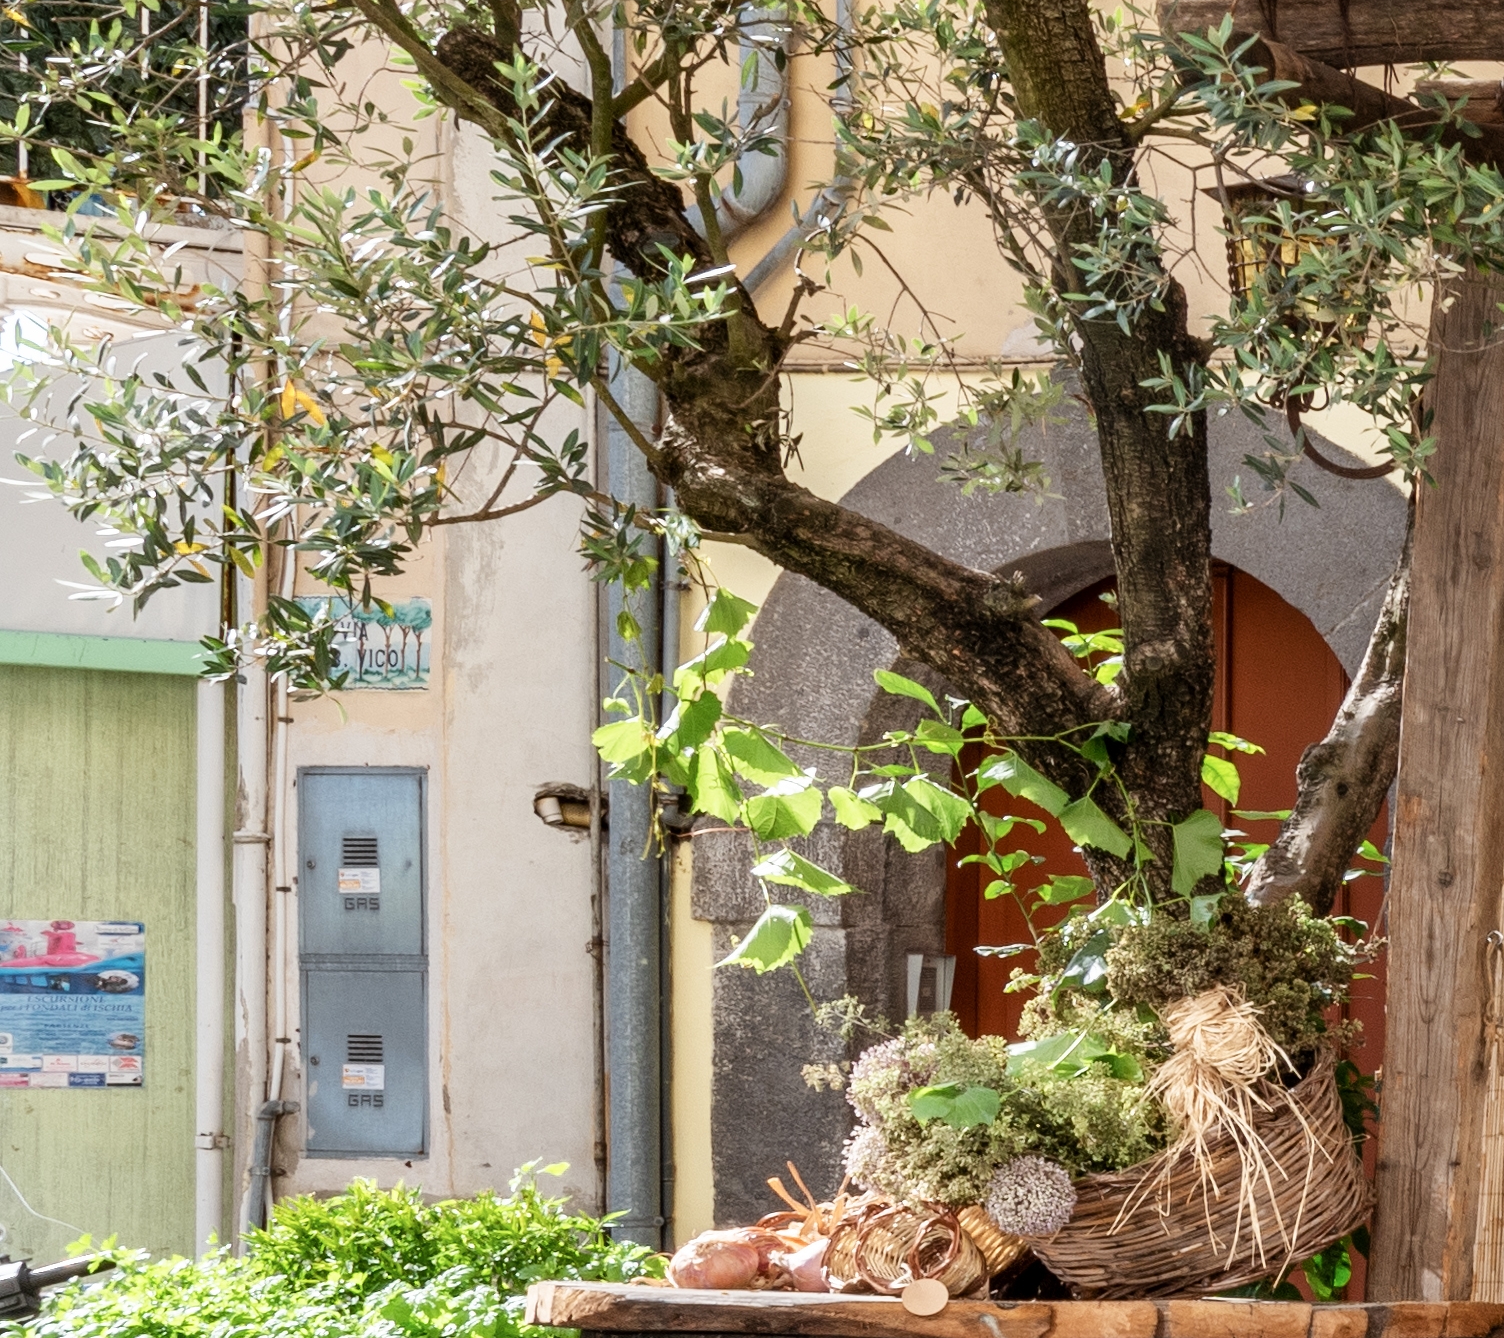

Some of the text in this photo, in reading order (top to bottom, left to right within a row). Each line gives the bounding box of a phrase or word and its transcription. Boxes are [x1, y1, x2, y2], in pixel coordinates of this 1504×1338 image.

[340, 620, 369, 642] VIA
[357, 648, 399, 668] VICO
[344, 897, 380, 911] GAS
[93, 1003, 133, 1012] ISCHIA
[348, 1094, 384, 1108] GAS
